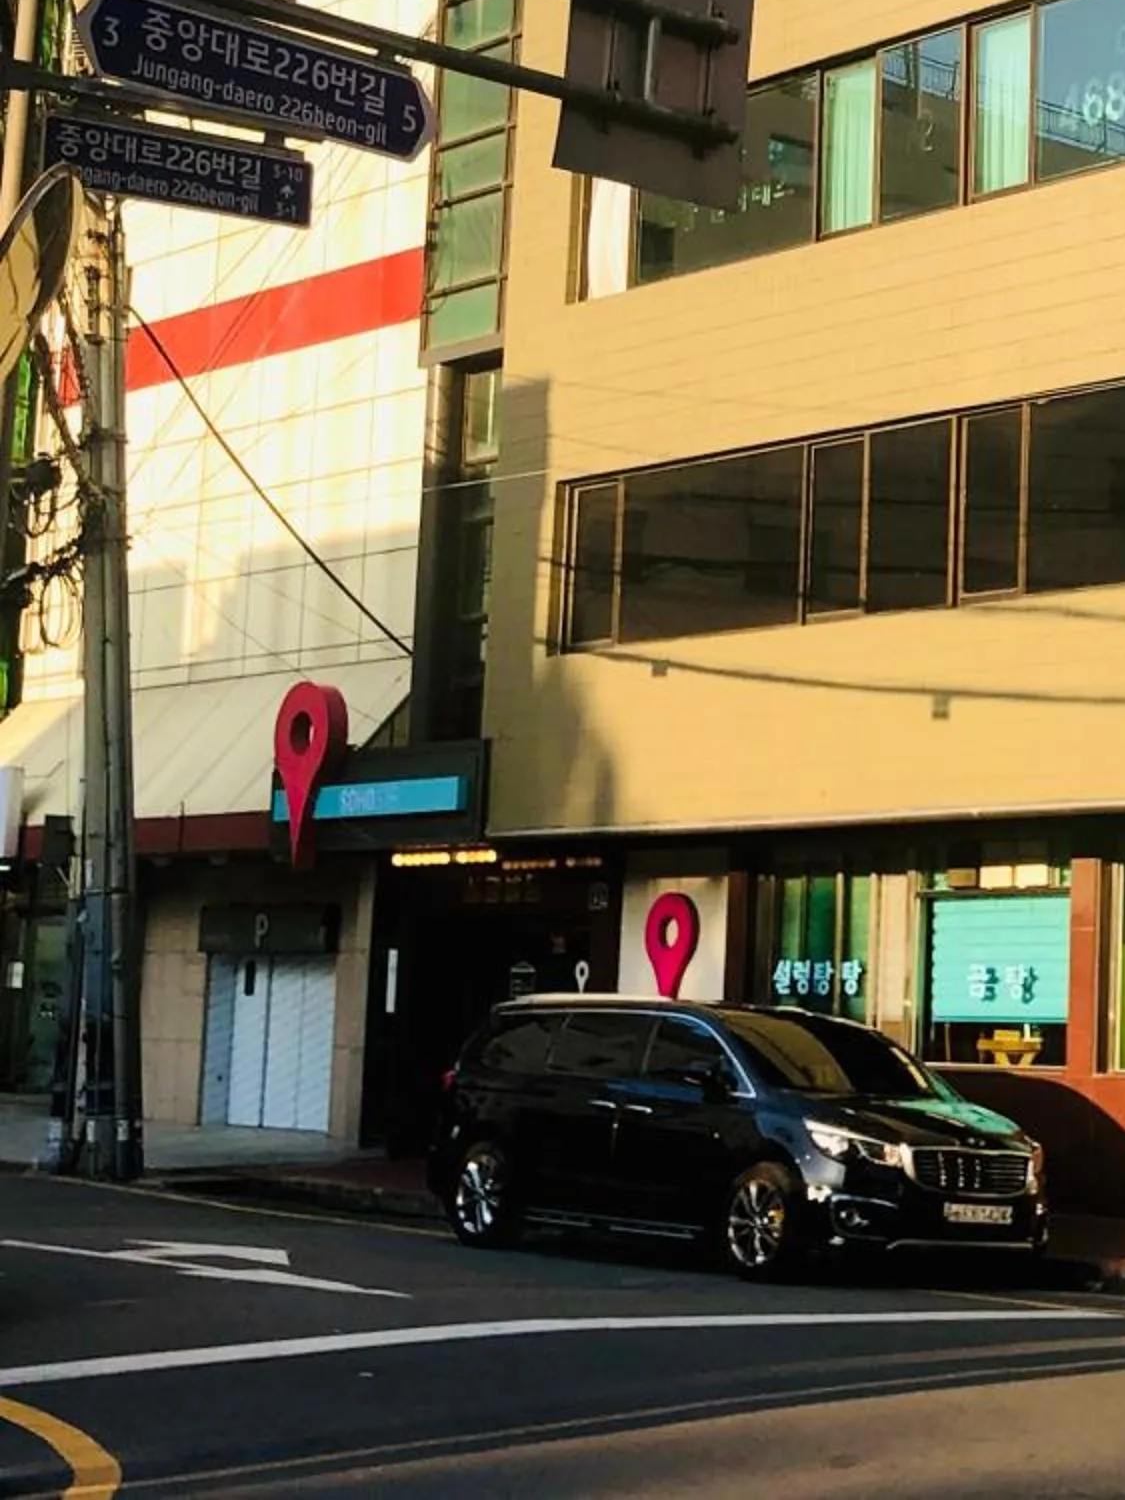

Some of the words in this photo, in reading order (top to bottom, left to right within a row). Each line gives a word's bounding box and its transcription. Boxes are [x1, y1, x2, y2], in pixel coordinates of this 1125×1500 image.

[101, 16, 119, 47] 3
[140, 7, 386, 117] 중앙대로226번길
[131, 53, 275, 113] Jungang-daero
[278, 96, 387, 147] 226beon-gil
[401, 104, 417, 133] 5
[56, 124, 262, 191] 중앙대로226번길
